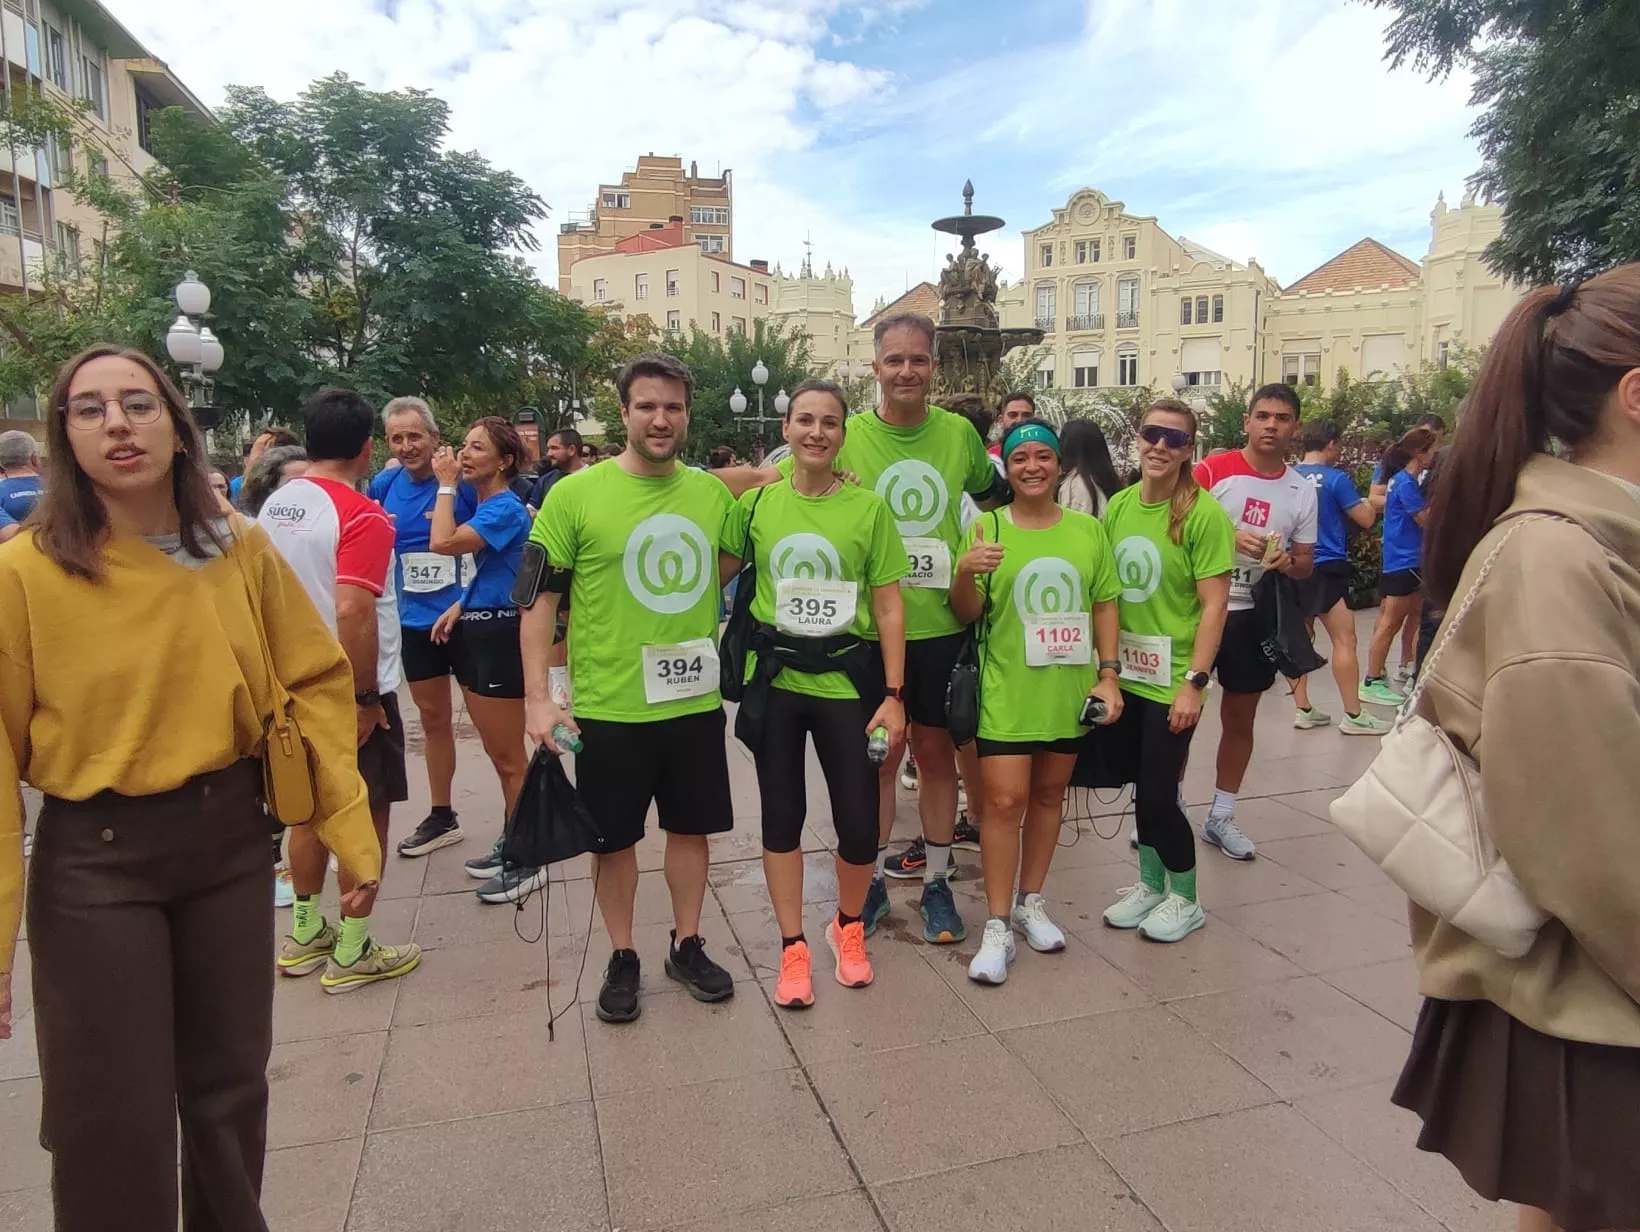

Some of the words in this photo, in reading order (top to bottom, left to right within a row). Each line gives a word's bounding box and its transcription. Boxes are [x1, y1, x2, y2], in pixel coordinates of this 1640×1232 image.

[907, 554, 934, 571] 93
[409, 566, 442, 579] 547
[1230, 567, 1252, 583] 41
[463, 610, 493, 621] PRO
[788, 597, 837, 618] 395
[798, 616, 833, 625] LAURA
[1035, 627, 1082, 644] 1102
[1047, 644, 1075, 652] CARLA
[1122, 647, 1160, 668] 1103
[656, 655, 704, 678] 394
[666, 674, 701, 686] RUBEN
